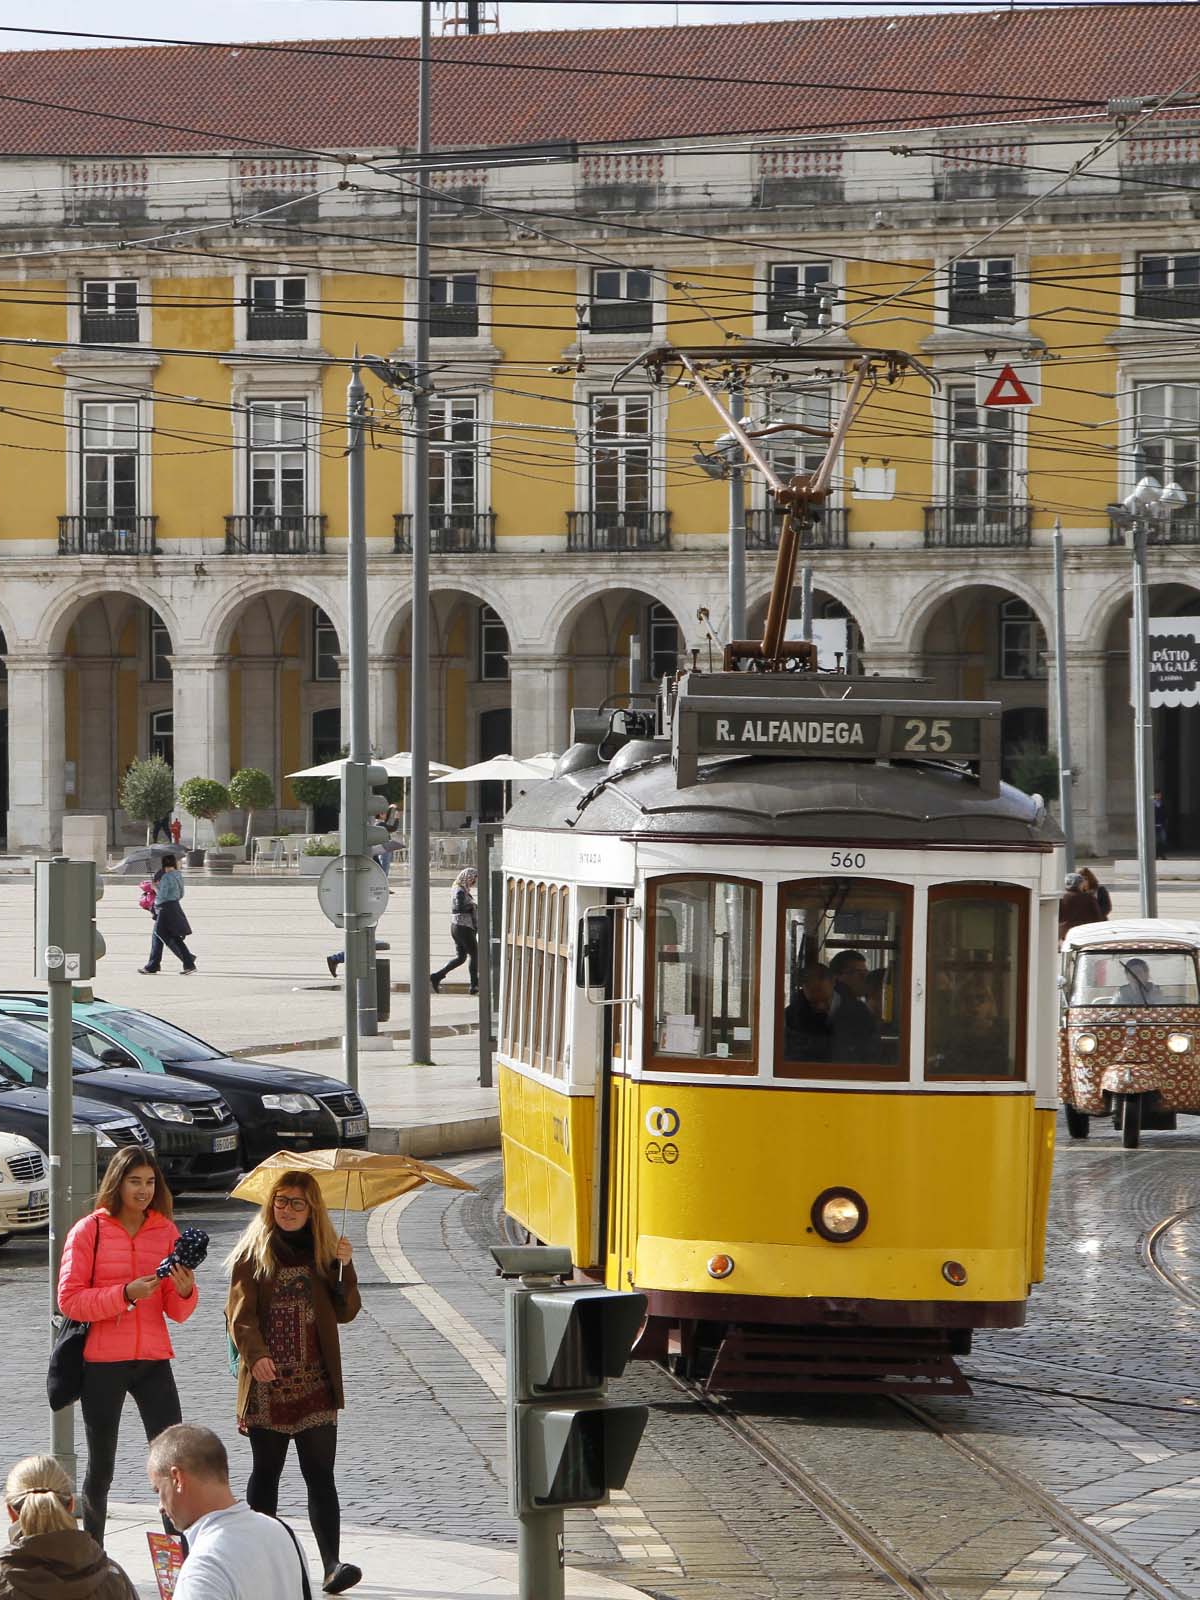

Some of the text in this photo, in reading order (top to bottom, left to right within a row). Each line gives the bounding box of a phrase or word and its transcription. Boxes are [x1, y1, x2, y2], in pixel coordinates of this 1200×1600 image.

[1152, 648, 1190, 661] PÁTIO
[1164, 659, 1198, 673] GALÉ
[716, 719, 864, 745] R. ALFANDEGA
[904, 719, 953, 752] 25
[830, 851, 866, 869] 560
